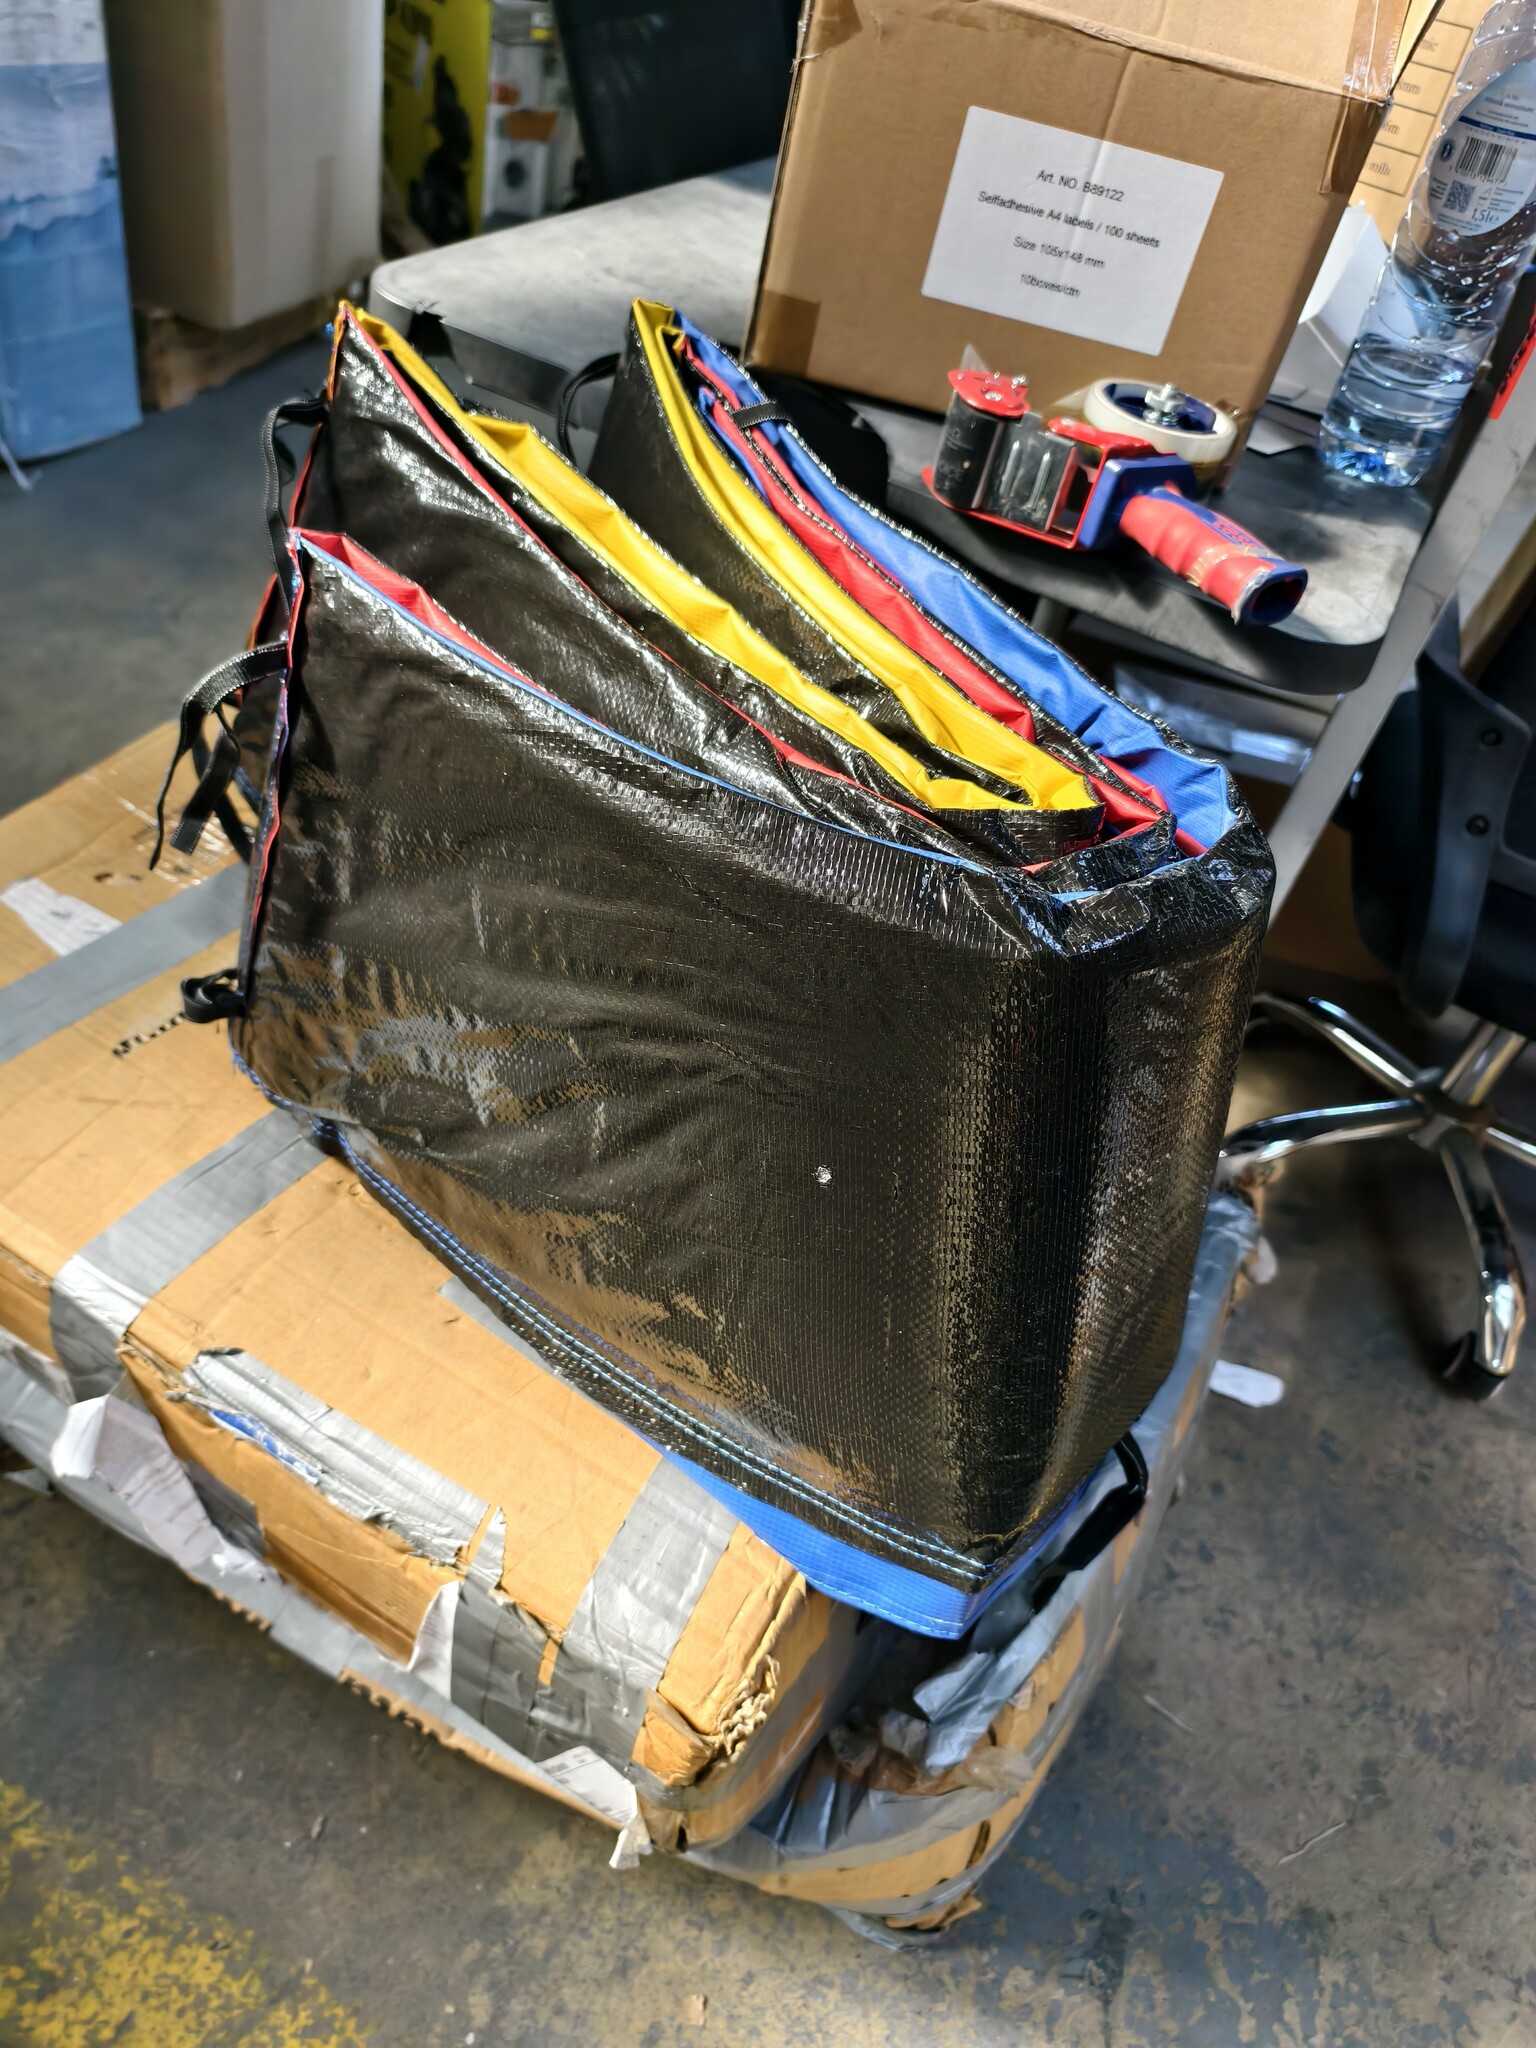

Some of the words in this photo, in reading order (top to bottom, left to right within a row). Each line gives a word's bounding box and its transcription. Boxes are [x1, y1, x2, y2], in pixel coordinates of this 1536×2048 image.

[1036, 170, 1055, 184] Art.
[1058, 175, 1079, 191] NO.
[1083, 181, 1125, 202] B89122
[978, 191, 1045, 218] Selfadhesive
[1046, 210, 1062, 222] A4
[1063, 214, 1095, 231] labels
[1105, 224, 1125, 239] 100
[1125, 231, 1160, 248] sheets
[1013, 236, 1037, 252] Size
[1041, 244, 1084, 264] 105x148
[1084, 257, 1105, 270] mm
